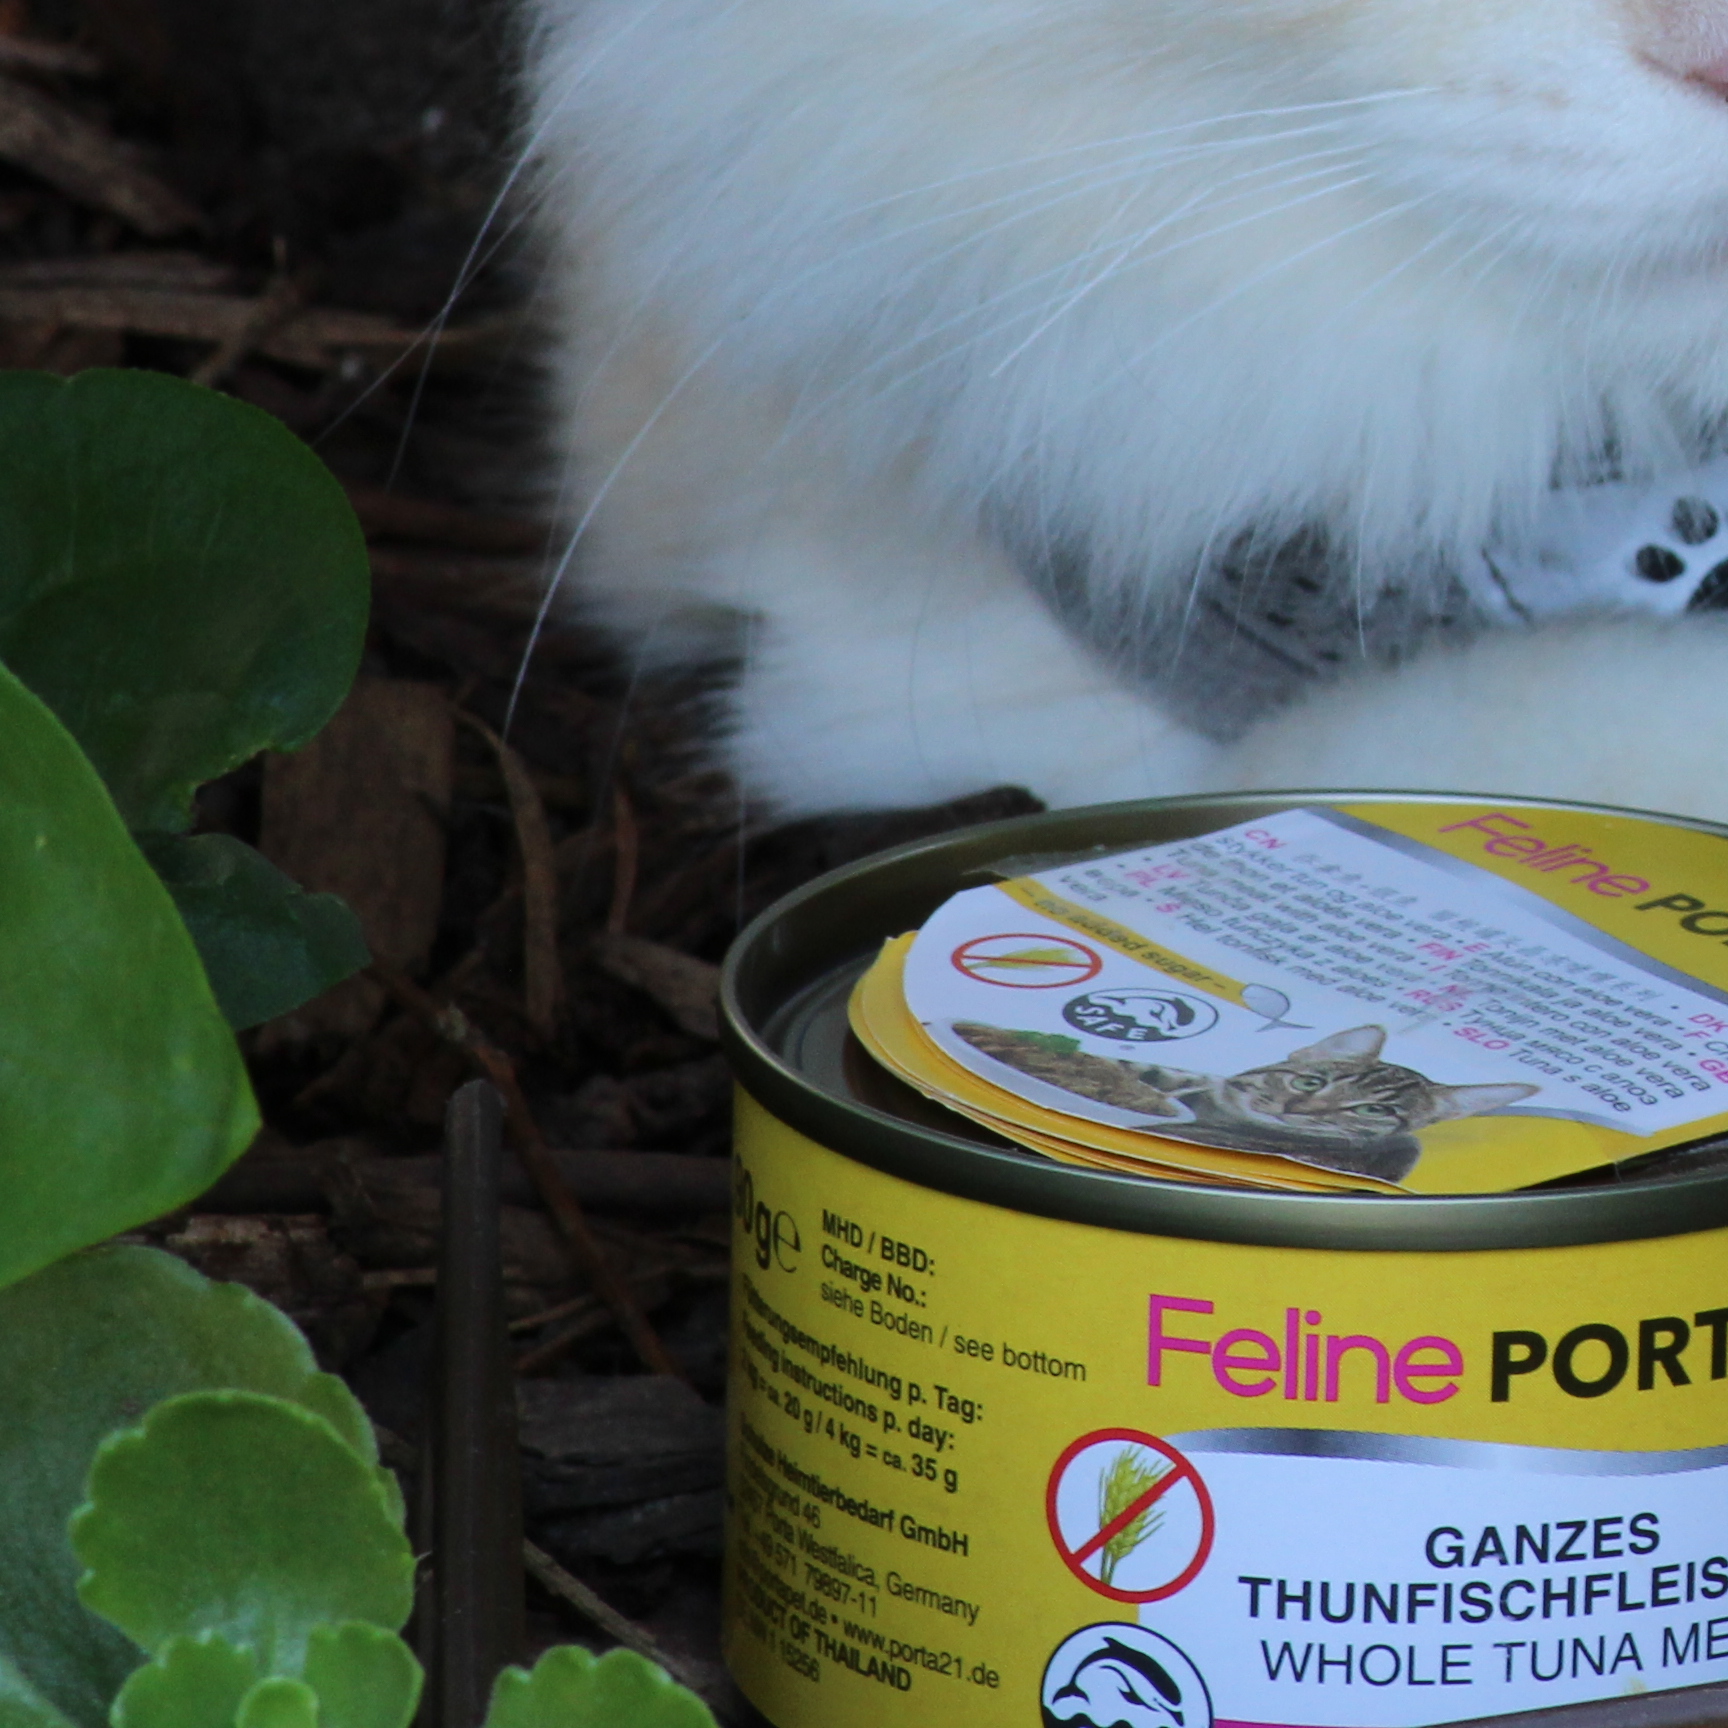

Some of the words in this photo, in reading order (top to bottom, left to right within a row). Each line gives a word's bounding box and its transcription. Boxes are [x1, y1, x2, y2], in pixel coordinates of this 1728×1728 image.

[1244, 830, 1286, 850] CN
[1437, 812, 1652, 898] Feline
[1075, 1004, 1147, 1040] SAFE
[1418, 943, 1463, 960] FIN
[1582, 1009, 1632, 1027] aloe
[1633, 1028, 1682, 1051] vera
[1573, 989, 1623, 1006] aloe
[1623, 1006, 1672, 1026] vera
[1683, 1029, 1711, 1041] F
[1453, 1027, 1510, 1049] SLO
[1509, 1048, 1563, 1075] Tuna
[1562, 1075, 1582, 1083] s
[1581, 1084, 1646, 1112] aloe
[1539, 1028, 1588, 1045] met
[1583, 1046, 1634, 1067] aloe
[1635, 1068, 1684, 1099] vera
[1569, 1021, 1612, 1038] con
[1610, 1038, 1661, 1060] aloe
[1662, 1059, 1712, 1092] vera
[821, 1243, 882, 1292] Charge
[887, 1272, 926, 1307] No.:
[822, 1208, 863, 1249] MHD
[881, 1235, 935, 1276] BBD:
[821, 1280, 864, 1318] siehe
[870, 1300, 933, 1345] Boden
[954, 1334, 994, 1362] see
[1003, 1342, 1087, 1382] bottom
[1147, 1293, 1464, 1404] Feline
[781, 1349, 878, 1423] instructions
[884, 1410, 902, 1434] p.
[908, 1415, 955, 1451] day:
[908, 1381, 928, 1406] p.
[934, 1384, 983, 1422] Tag:
[803, 1409, 814, 1434] g
[826, 1417, 835, 1440] 4
[839, 1422, 861, 1459] kg
[883, 1449, 908, 1473] ca.
[911, 1451, 937, 1480] 35
[944, 1468, 958, 1494] g
[900, 1515, 969, 1557] GmbH
[1425, 1512, 1660, 1569] GANZES
[804, 1561, 877, 1618] 79897-11
[886, 1570, 980, 1627] Germany
[814, 1627, 912, 1692] THAILAND
[843, 1616, 1000, 1689] www.porta21.de
[1260, 1638, 1474, 1687] WHOLE
[1493, 1633, 1644, 1683] TUNA
